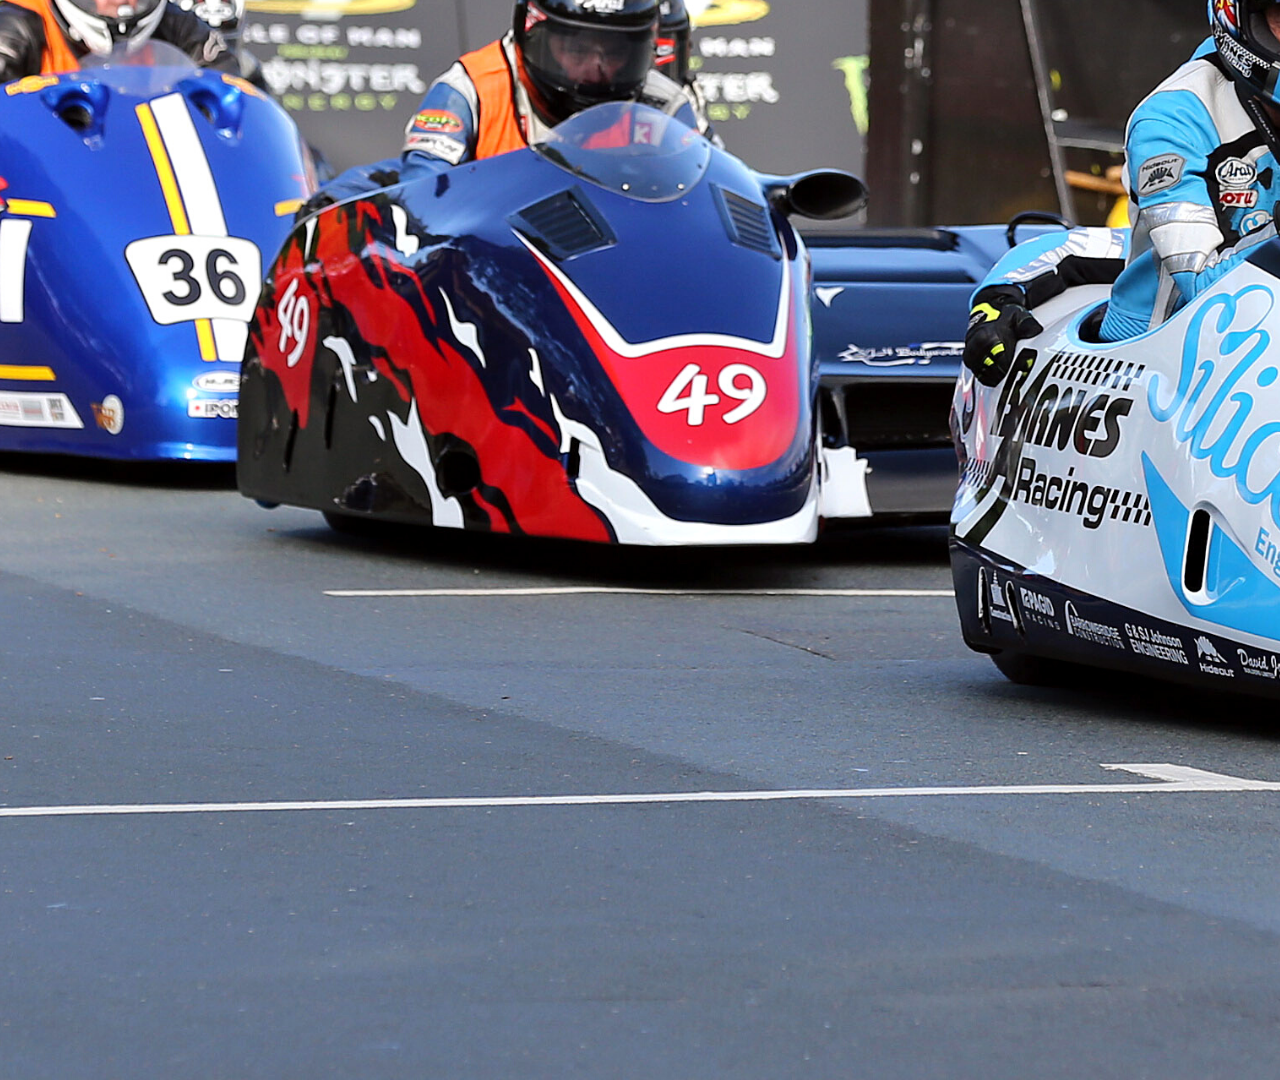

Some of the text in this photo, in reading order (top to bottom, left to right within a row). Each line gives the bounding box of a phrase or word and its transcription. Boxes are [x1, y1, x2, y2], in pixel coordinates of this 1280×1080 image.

[1221, 163, 1252, 177] Arai
[158, 248, 246, 306] 36
[277, 278, 311, 367] 49
[656, 363, 766, 426] 49
[1013, 457, 1111, 530] Racing
[1131, 640, 1189, 665] ENGINEERING
[1150, 630, 1183, 648] Johnson
[1236, 648, 1269, 670] David
